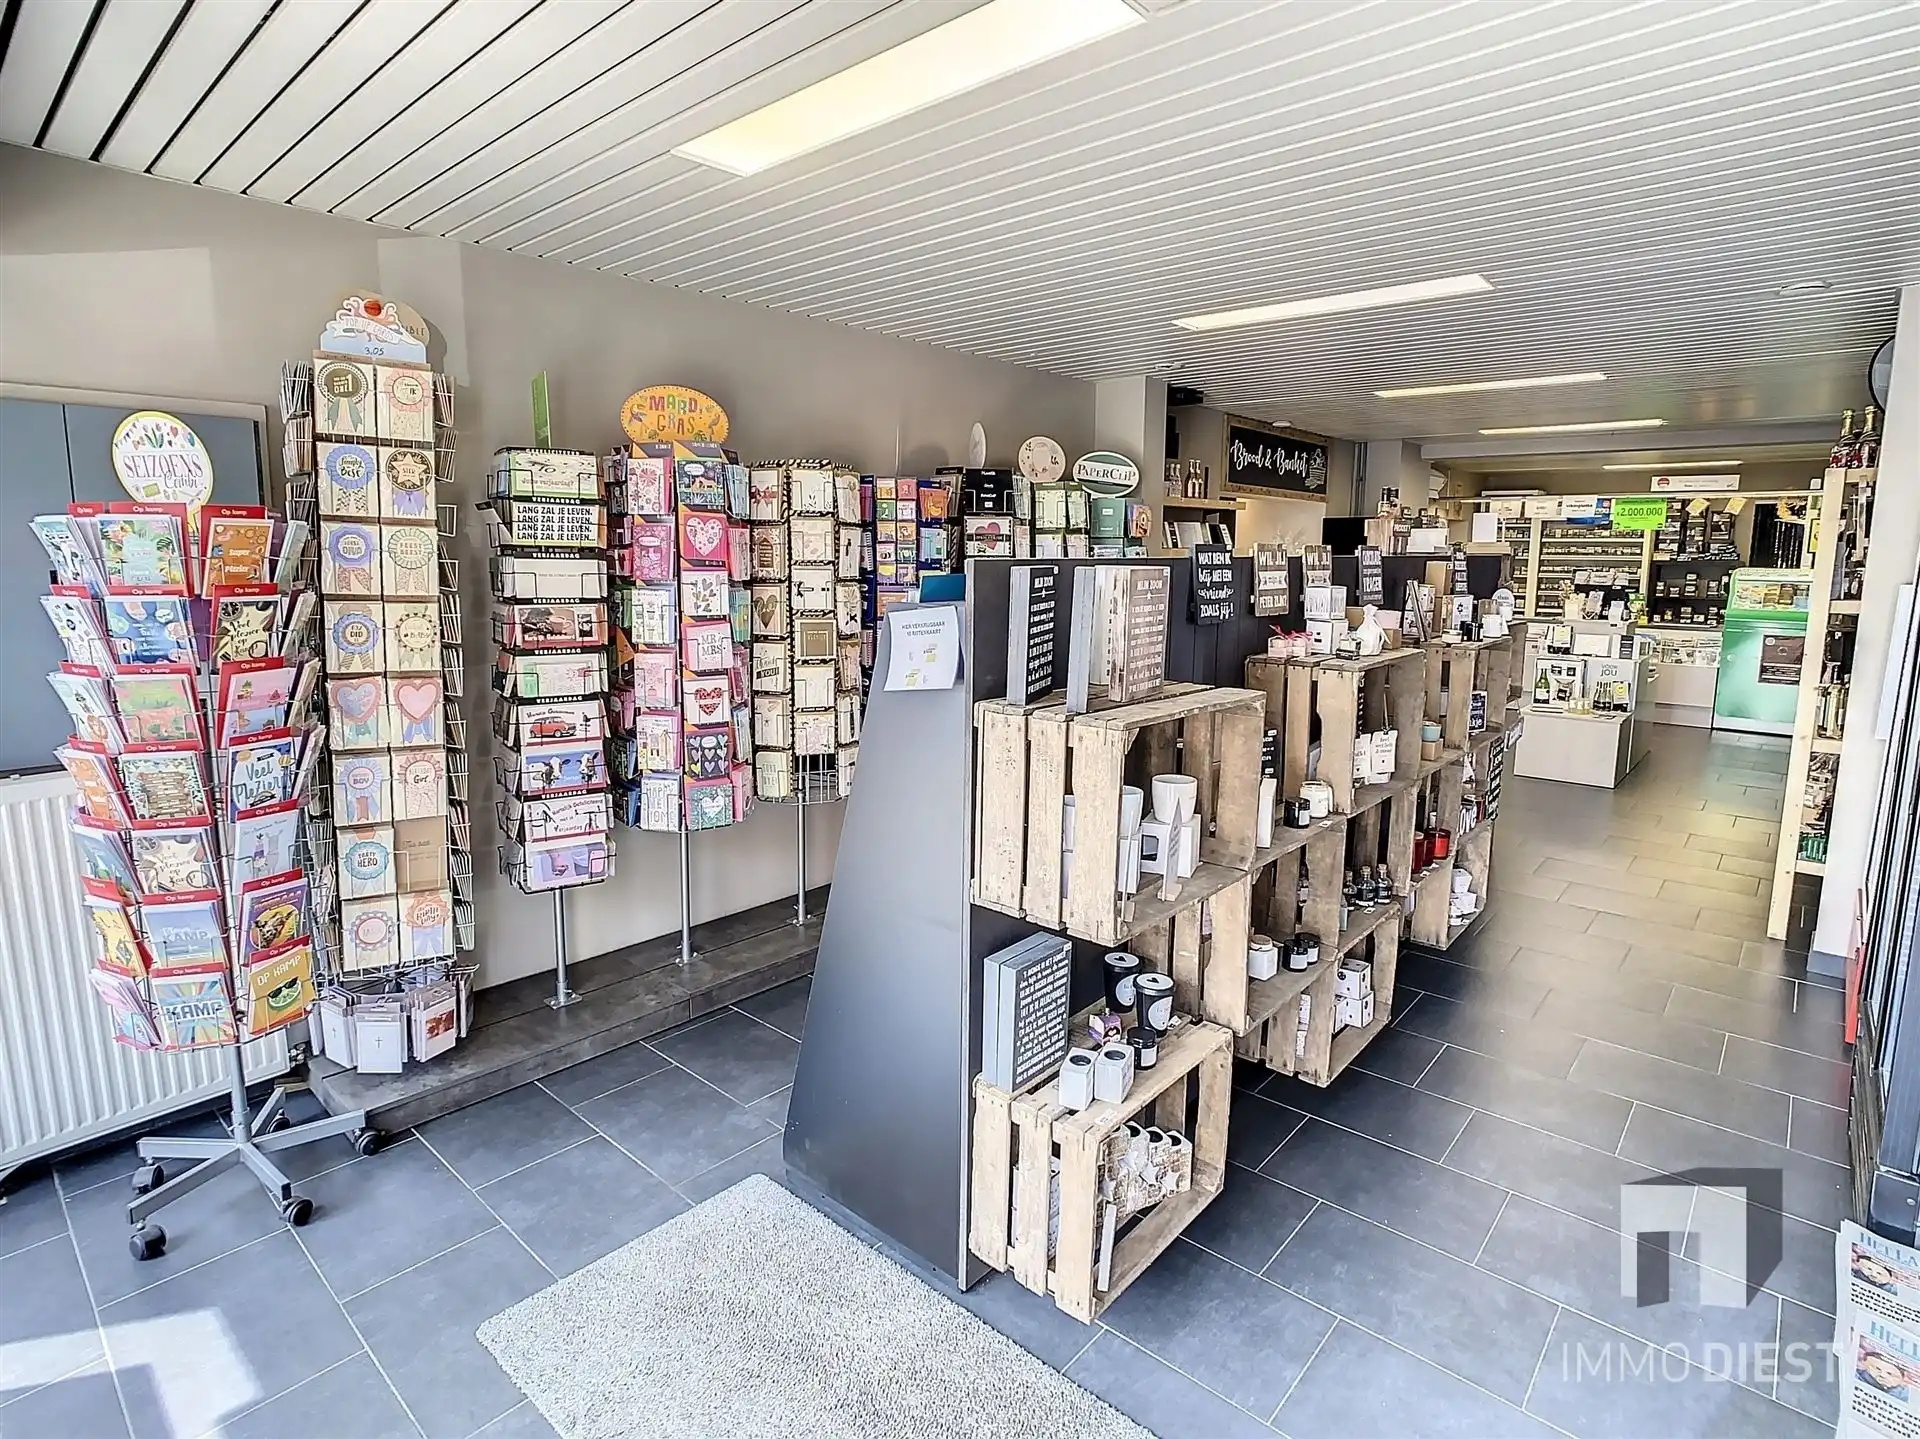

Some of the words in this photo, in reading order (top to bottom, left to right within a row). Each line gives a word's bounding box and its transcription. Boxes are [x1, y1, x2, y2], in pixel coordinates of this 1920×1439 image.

[364, 346, 385, 356] 3.05
[656, 412, 696, 436] GRAS
[122, 453, 204, 479] SEIZOENS
[1230, 439, 1265, 471] Brood
[1264, 448, 1272, 470] &
[1272, 447, 1309, 478] Banket
[517, 505, 539, 514] LANG
[540, 505, 556, 515] ZAL
[556, 506, 566, 516] JE
[566, 506, 592, 516] LEVEN.
[517, 515, 539, 523] LANG
[540, 515, 556, 524] ZAL
[556, 516, 566, 524] JE
[566, 516, 592, 524] LEVEN.
[517, 524, 539, 532] LANG
[540, 524, 556, 532] ZAL
[556, 524, 566, 533] JE
[566, 524, 592, 534] LEVEN.
[517, 532, 539, 540] LANG
[540, 532, 556, 541] ZAL
[556, 534, 566, 542] JE
[1258, 551, 1274, 566] WIL
[1200, 603, 1220, 618] ZOALS
[1600, 668, 1618, 677] JOU
[246, 760, 274, 781] Veel
[357, 857, 378, 869] HERO
[256, 971, 270, 986] OP
[164, 1000, 224, 1020] KAMP
